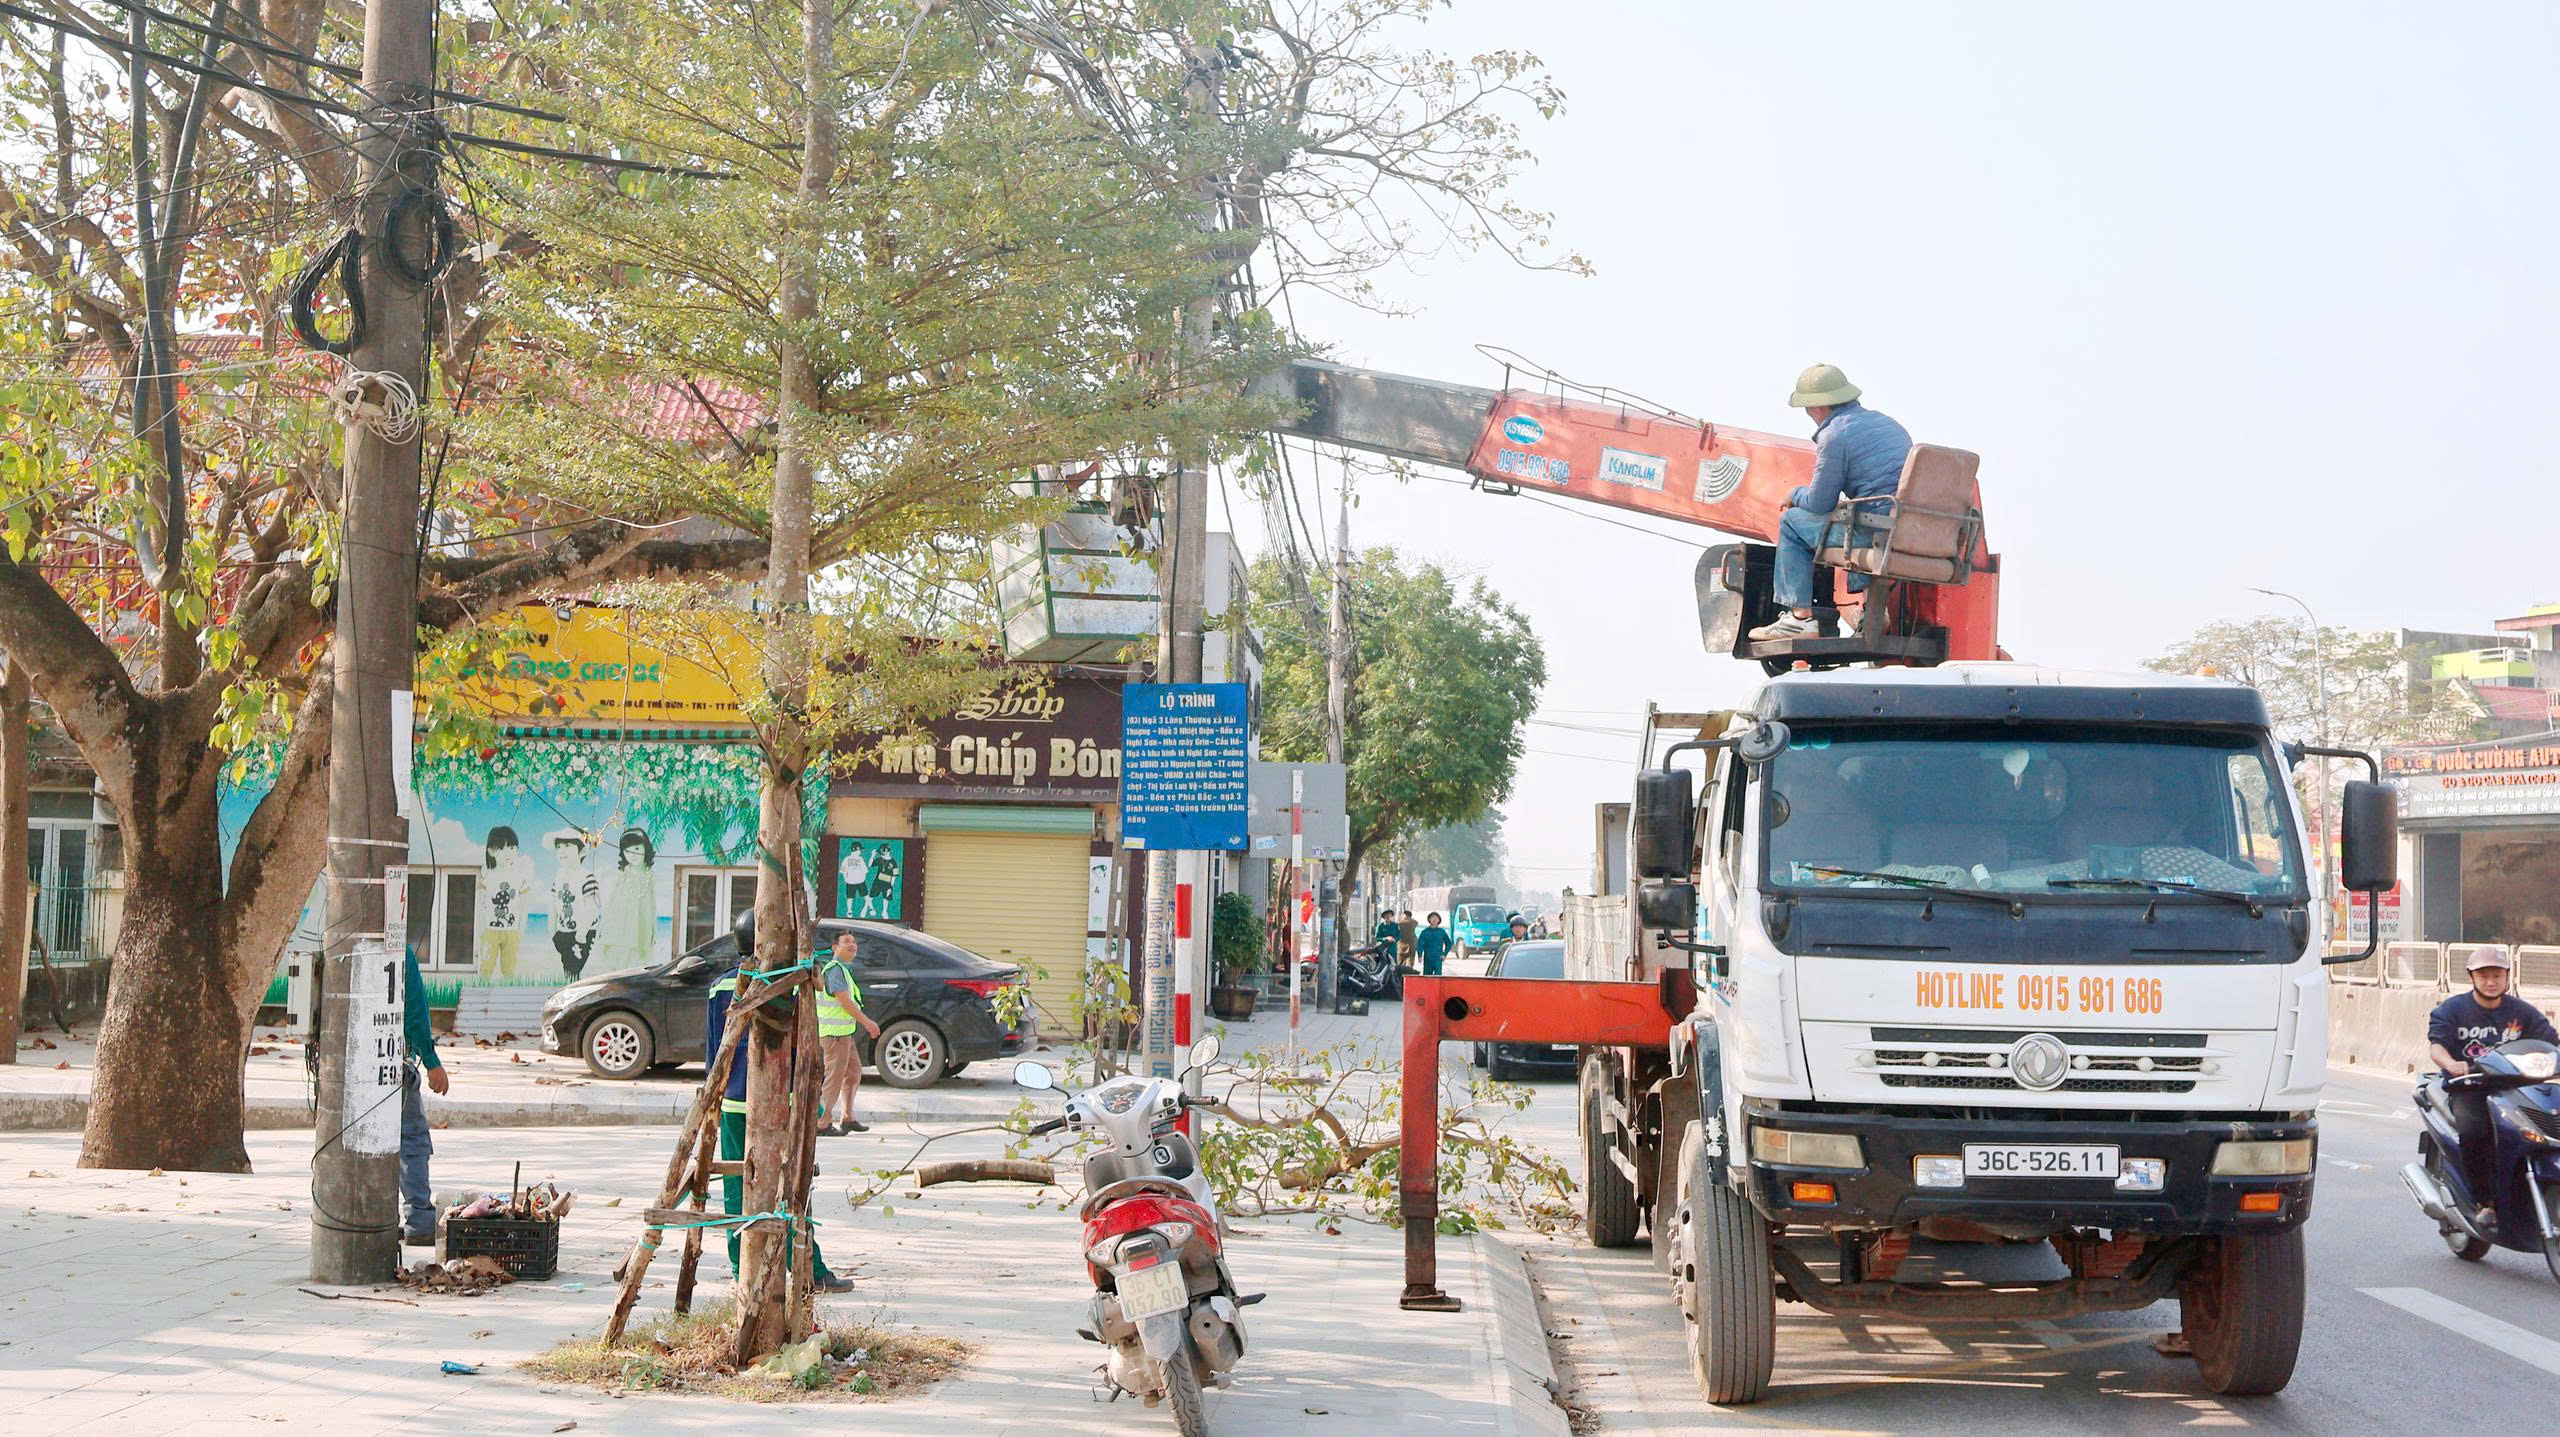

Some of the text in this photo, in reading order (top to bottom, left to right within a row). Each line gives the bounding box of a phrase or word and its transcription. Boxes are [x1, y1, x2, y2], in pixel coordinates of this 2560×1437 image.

[1608, 456, 1656, 481] KANGLIM
[716, 703, 725, 711] TT
[1160, 691, 1216, 710] LỘ TRÌNH
[1158, 716, 1164, 724] 3
[1173, 727, 1178, 735] 3
[950, 731, 1036, 786] Chíp
[1140, 760, 1159, 768] UBND
[2436, 745, 2473, 773] QUỐC
[2474, 744, 2526, 769] CƯỜNG
[1164, 771, 1184, 779] UBND
[1236, 792, 1242, 800] 3
[1916, 971, 2163, 1015] HOTLINE 0915 981 686
[1977, 1150, 2104, 1173] 36C-526.11
